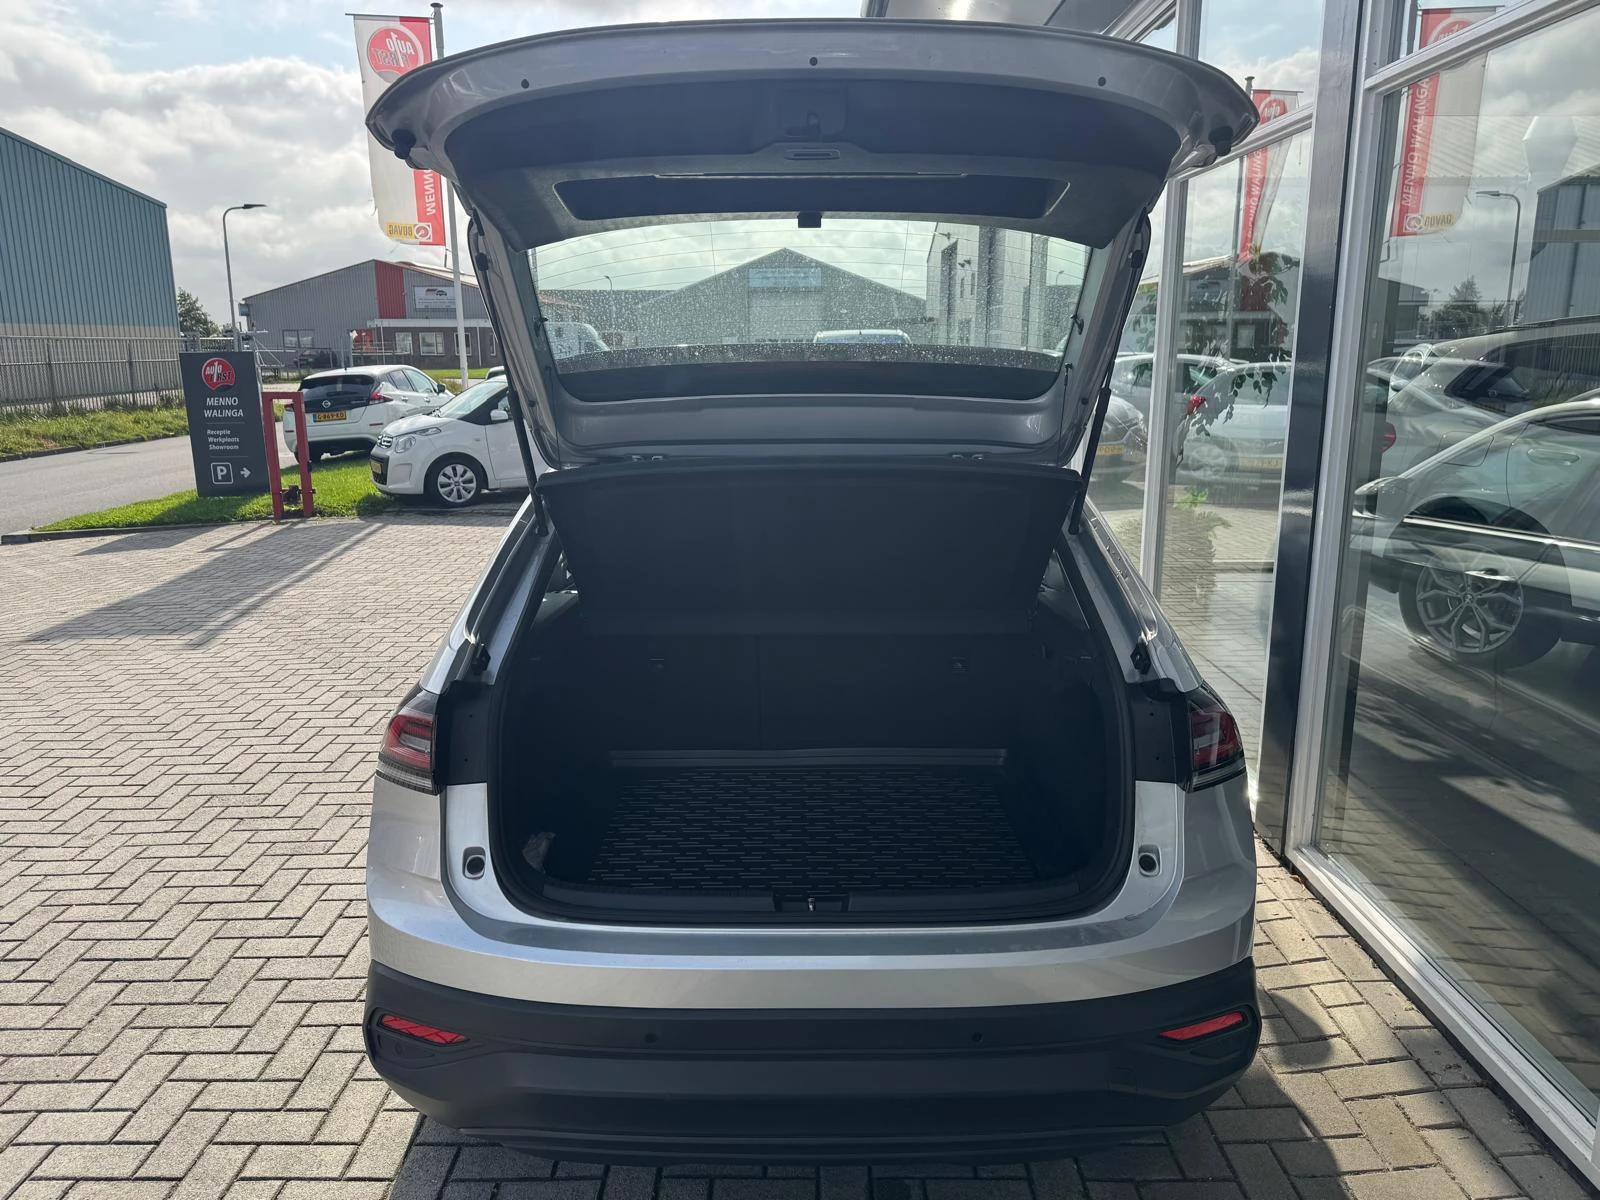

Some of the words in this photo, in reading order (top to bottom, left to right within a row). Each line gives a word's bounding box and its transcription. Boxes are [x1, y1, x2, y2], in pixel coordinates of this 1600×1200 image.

[206, 396, 239, 406] MENNO
[204, 408, 244, 418] WALINGA
[216, 465, 228, 481] P
